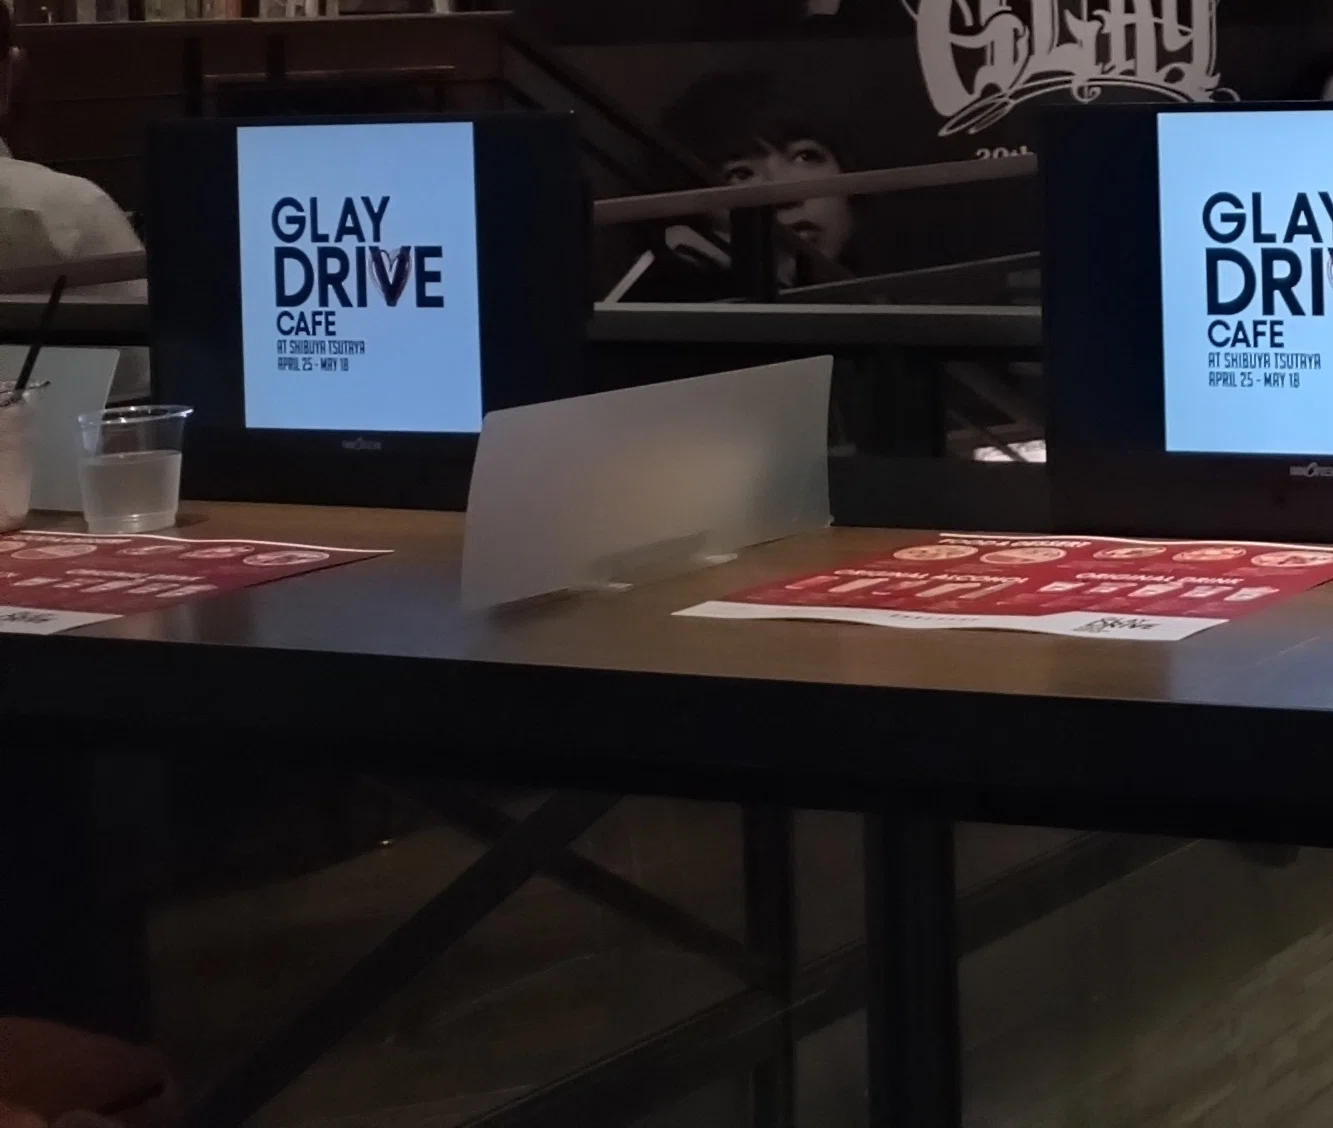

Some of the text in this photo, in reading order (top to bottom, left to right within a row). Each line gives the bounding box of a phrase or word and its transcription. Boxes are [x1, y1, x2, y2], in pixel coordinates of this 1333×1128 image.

[271, 195, 390, 244] GLAY
[274, 245, 445, 308] DRIVE
[276, 310, 336, 336] CAFE
[1207, 319, 1285, 349] CAFE
[277, 340, 365, 355] AT SHIBUYA TSUTAYA
[277, 357, 300, 371] APRIL
[302, 357, 313, 371] 25
[320, 357, 337, 372] MAY
[340, 357, 349, 372] 18
[1208, 352, 1321, 369] AT SHIBUYA TSUTAYA
[1208, 371, 1237, 387] APRIL
[1240, 372, 1253, 388] 25
[1263, 372, 1286, 388] MAY
[1289, 373, 1300, 388] 18
